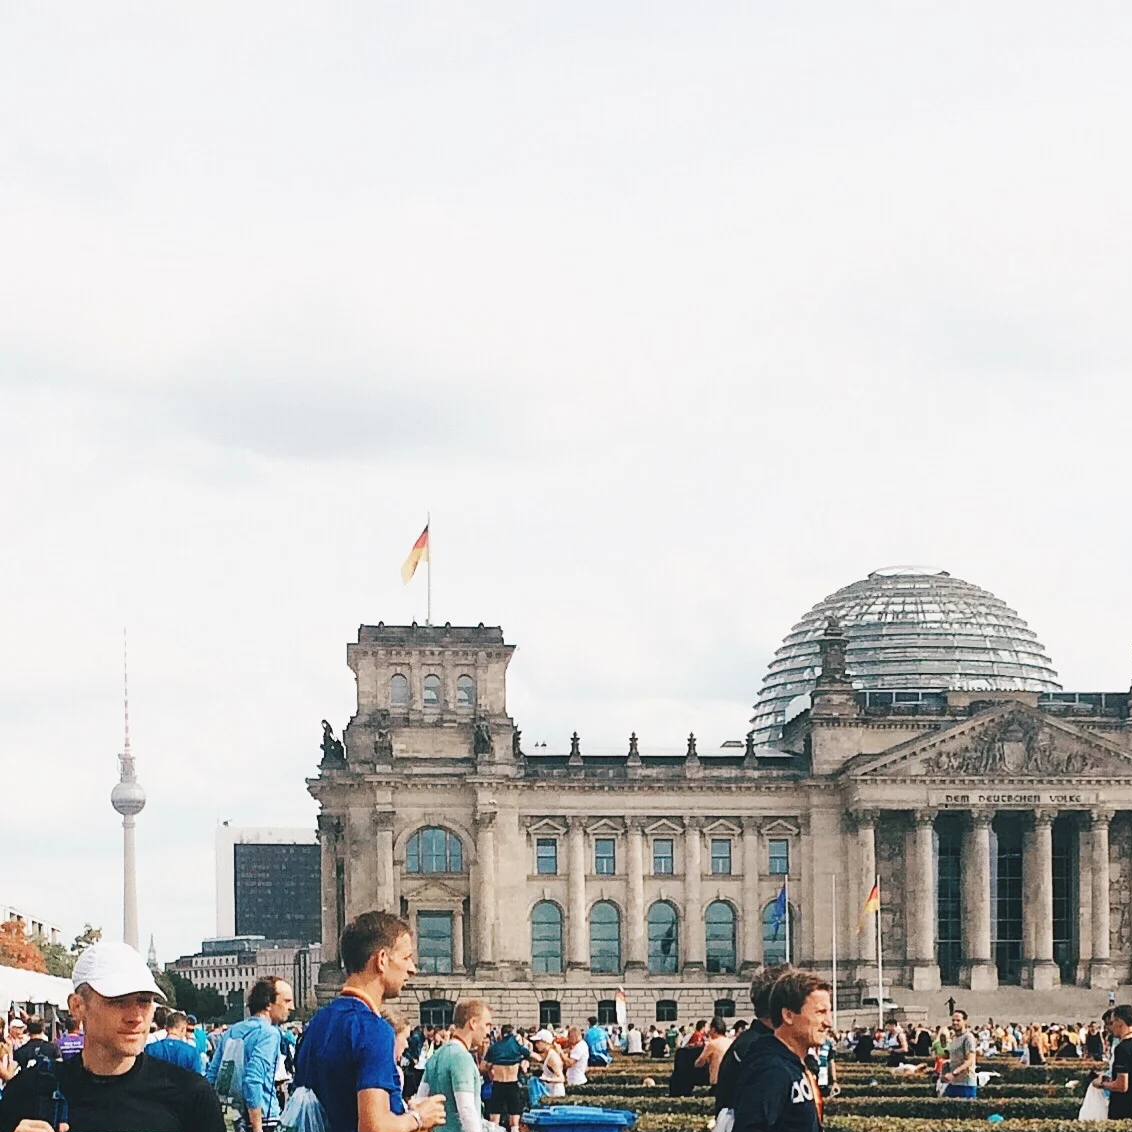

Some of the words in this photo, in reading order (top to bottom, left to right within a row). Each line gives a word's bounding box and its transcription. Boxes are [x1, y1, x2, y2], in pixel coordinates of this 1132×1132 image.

[945, 794, 970, 803] DEM
[978, 794, 1041, 803] DEUTSCHEN
[1049, 794, 1082, 803] VOLKE
